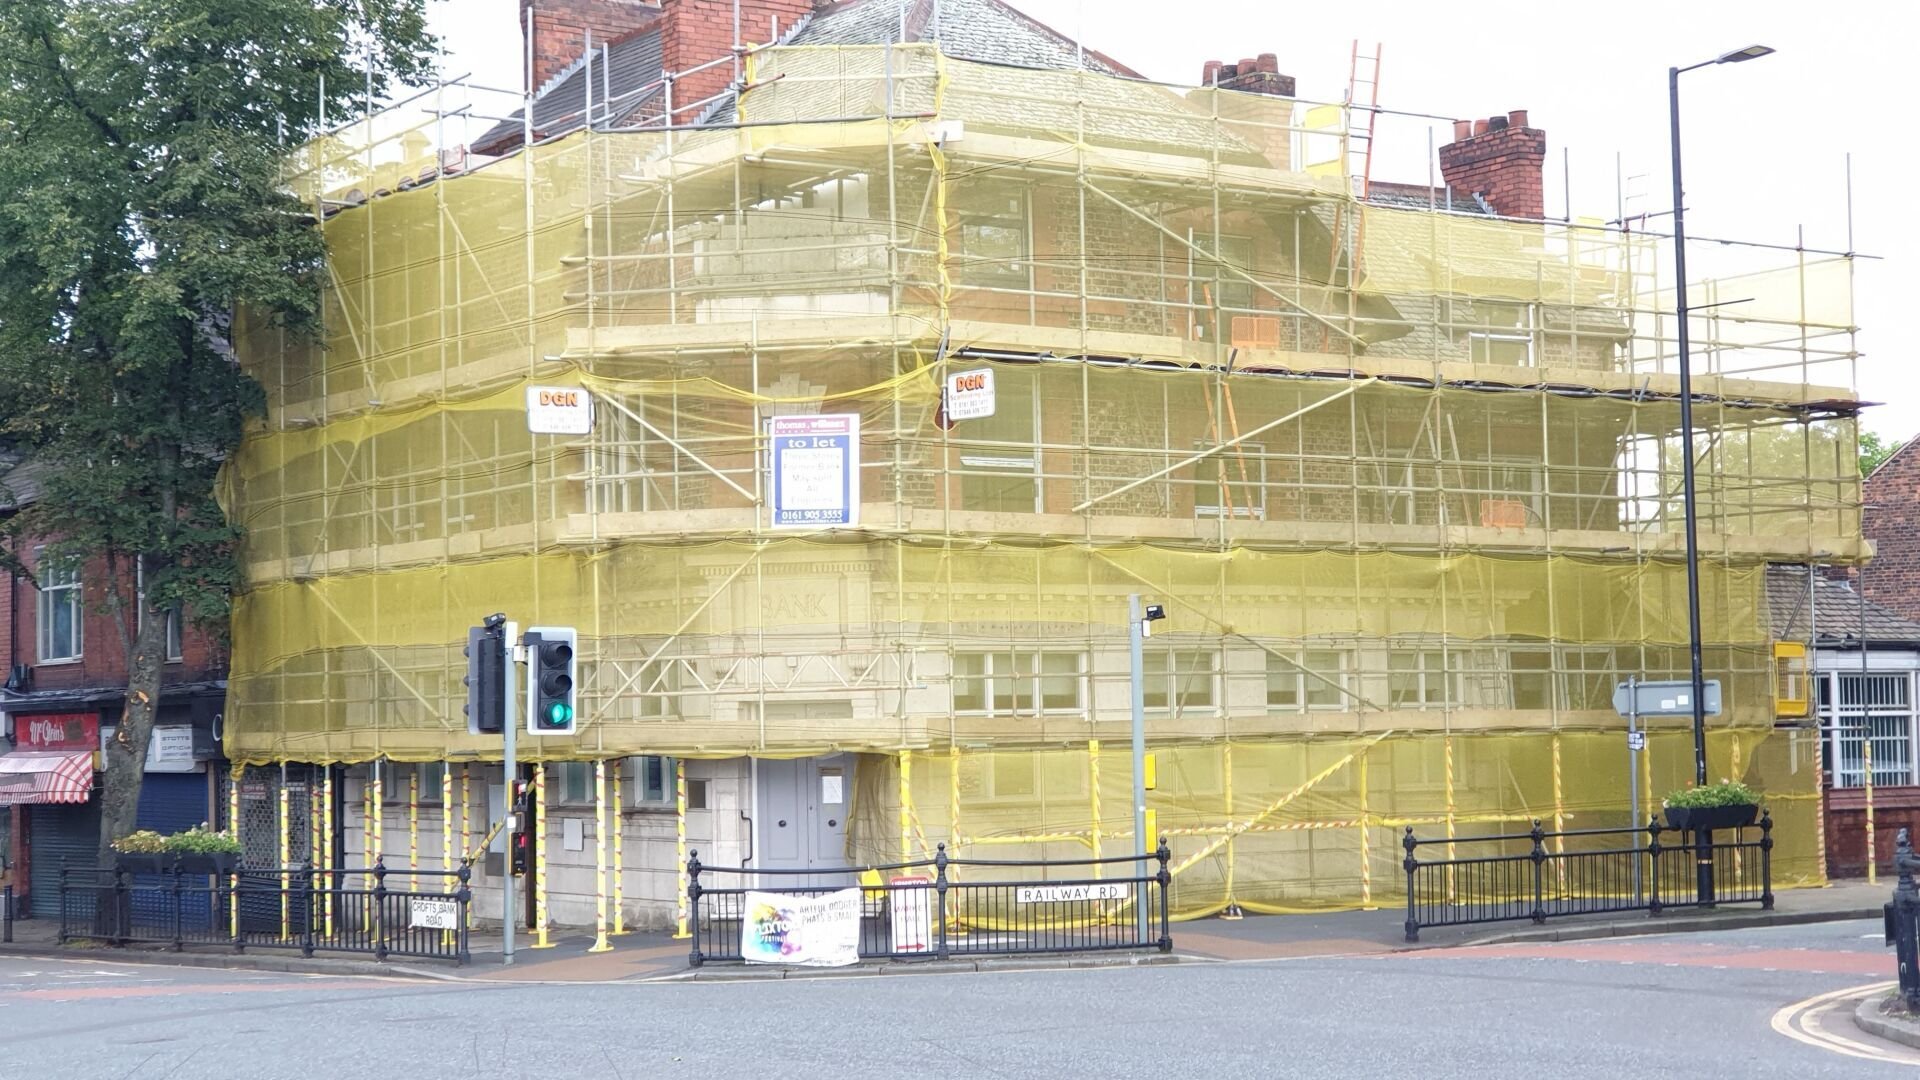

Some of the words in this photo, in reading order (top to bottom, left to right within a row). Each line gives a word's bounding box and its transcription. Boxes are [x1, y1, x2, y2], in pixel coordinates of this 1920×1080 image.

[956, 374, 985, 393] DGN
[539, 391, 578, 407] DGN
[788, 438, 807, 448] to
[813, 437, 836, 448] let
[782, 511, 802, 520] 0161
[804, 510, 820, 519] 905
[822, 509, 843, 519] 3555
[1024, 887, 1090, 902] RAILWAY
[1099, 886, 1118, 898] RD
[412, 901, 437, 913] CROFTS
[438, 902, 456, 914] BANK
[425, 915, 443, 926] ROAD
